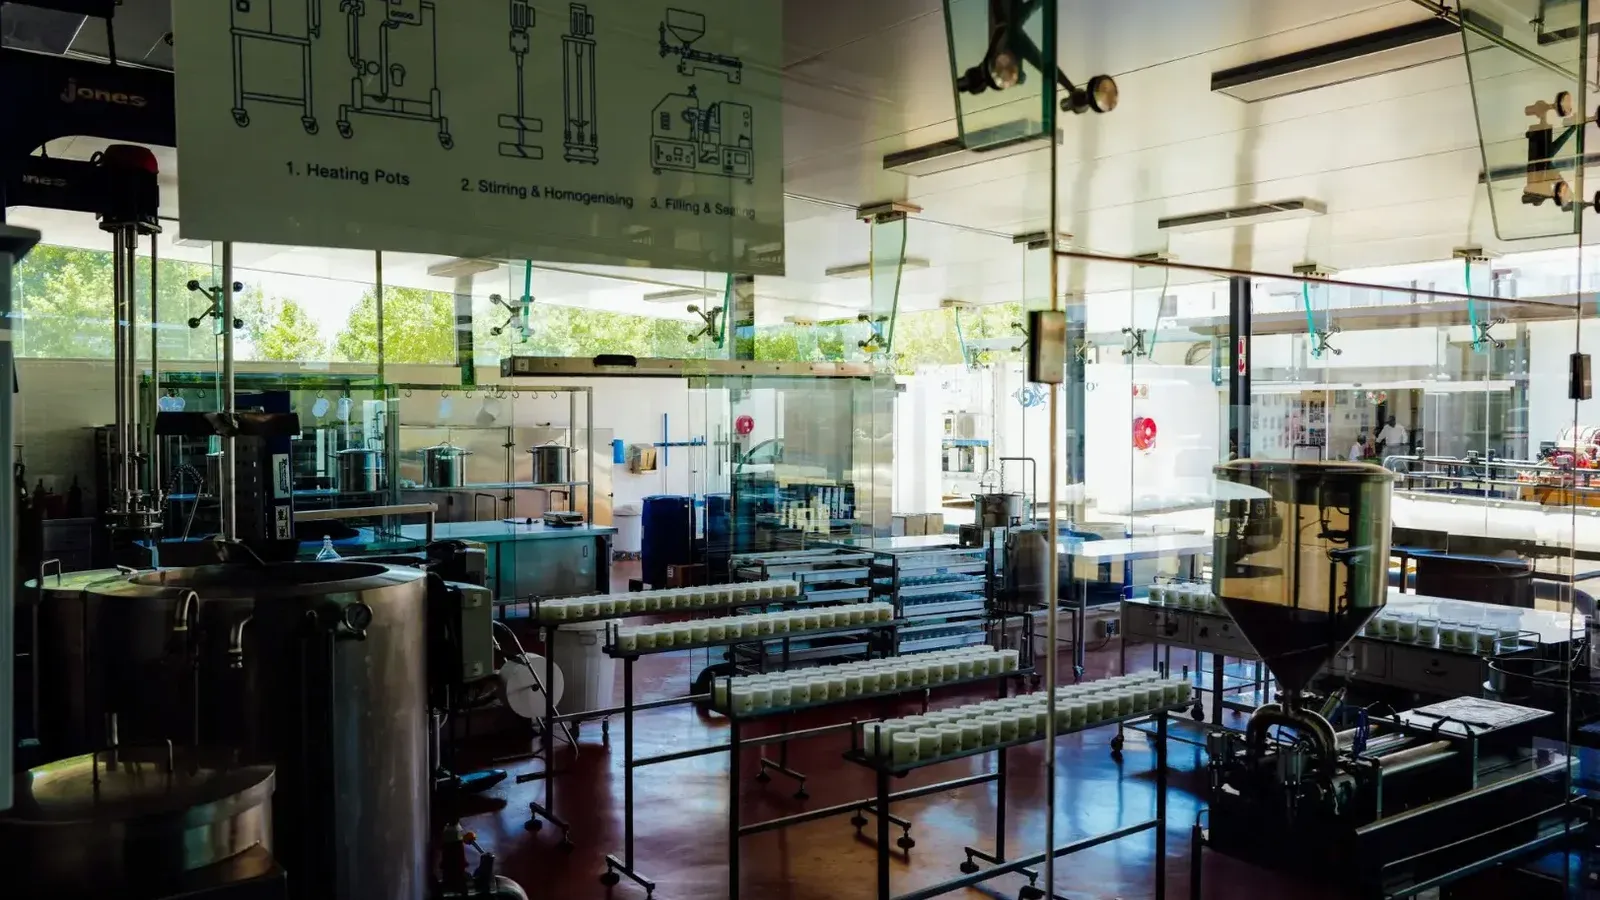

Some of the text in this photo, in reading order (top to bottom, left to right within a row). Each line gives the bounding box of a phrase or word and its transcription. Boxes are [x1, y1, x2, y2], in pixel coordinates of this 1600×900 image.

[60, 77, 148, 108] jones
[286, 160, 410, 186] 1. Heating Pots
[461, 178, 634, 208] 2. Stirring & Homogenising
[650, 196, 756, 220] 3. Filling & Seang
